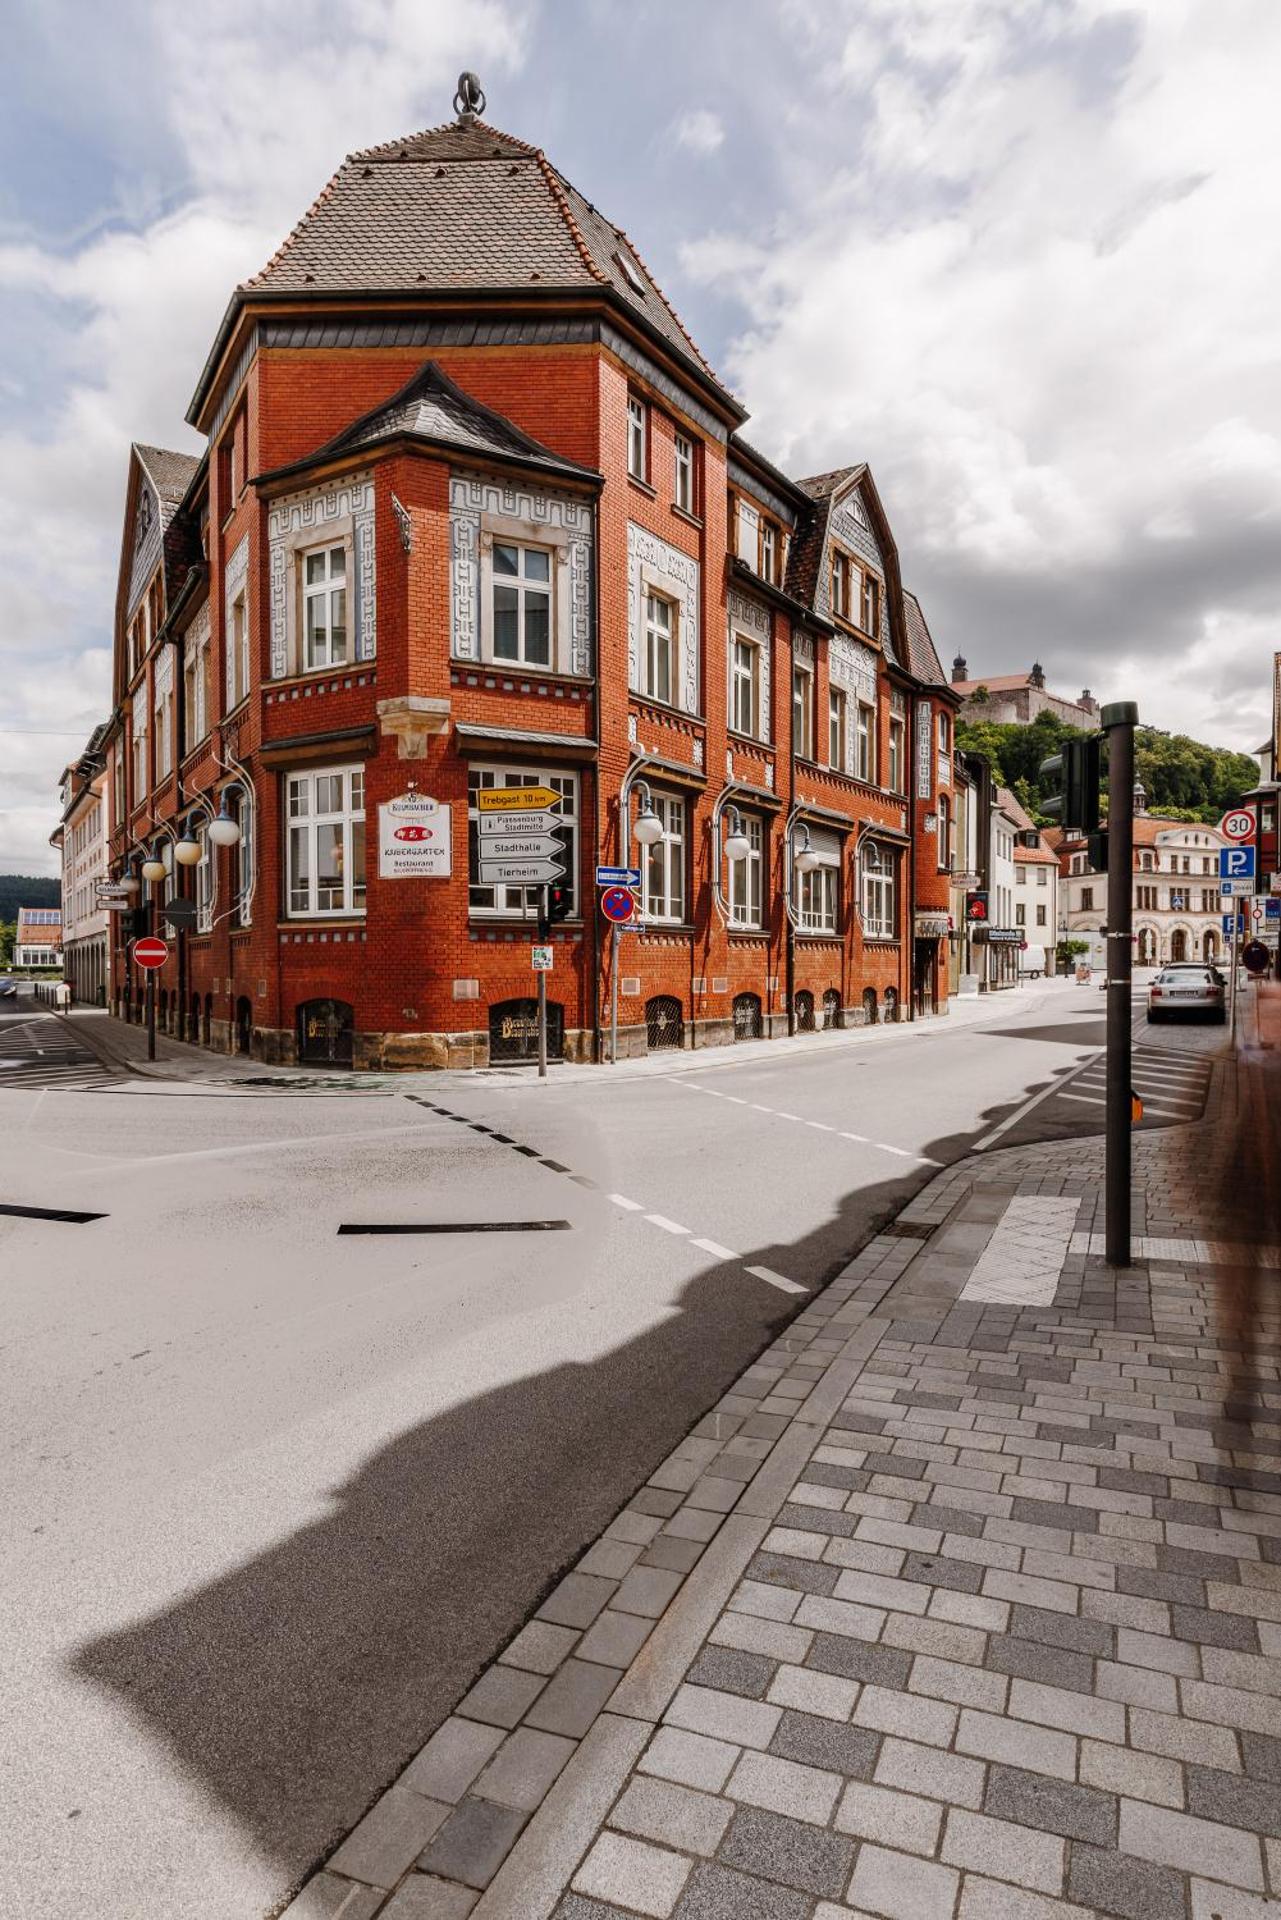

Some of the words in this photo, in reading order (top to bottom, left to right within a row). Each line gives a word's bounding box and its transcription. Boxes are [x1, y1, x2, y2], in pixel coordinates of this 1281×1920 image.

[482, 794, 520, 806] Trebgast
[524, 794, 533, 803] 10
[497, 816, 544, 825] Plassenburg
[1229, 818, 1249, 833] 30
[504, 824, 544, 832] Stadtmitte
[494, 843, 541, 853] Stadthalle
[1227, 850, 1248, 875] P
[497, 868, 538, 877] Tierheim
